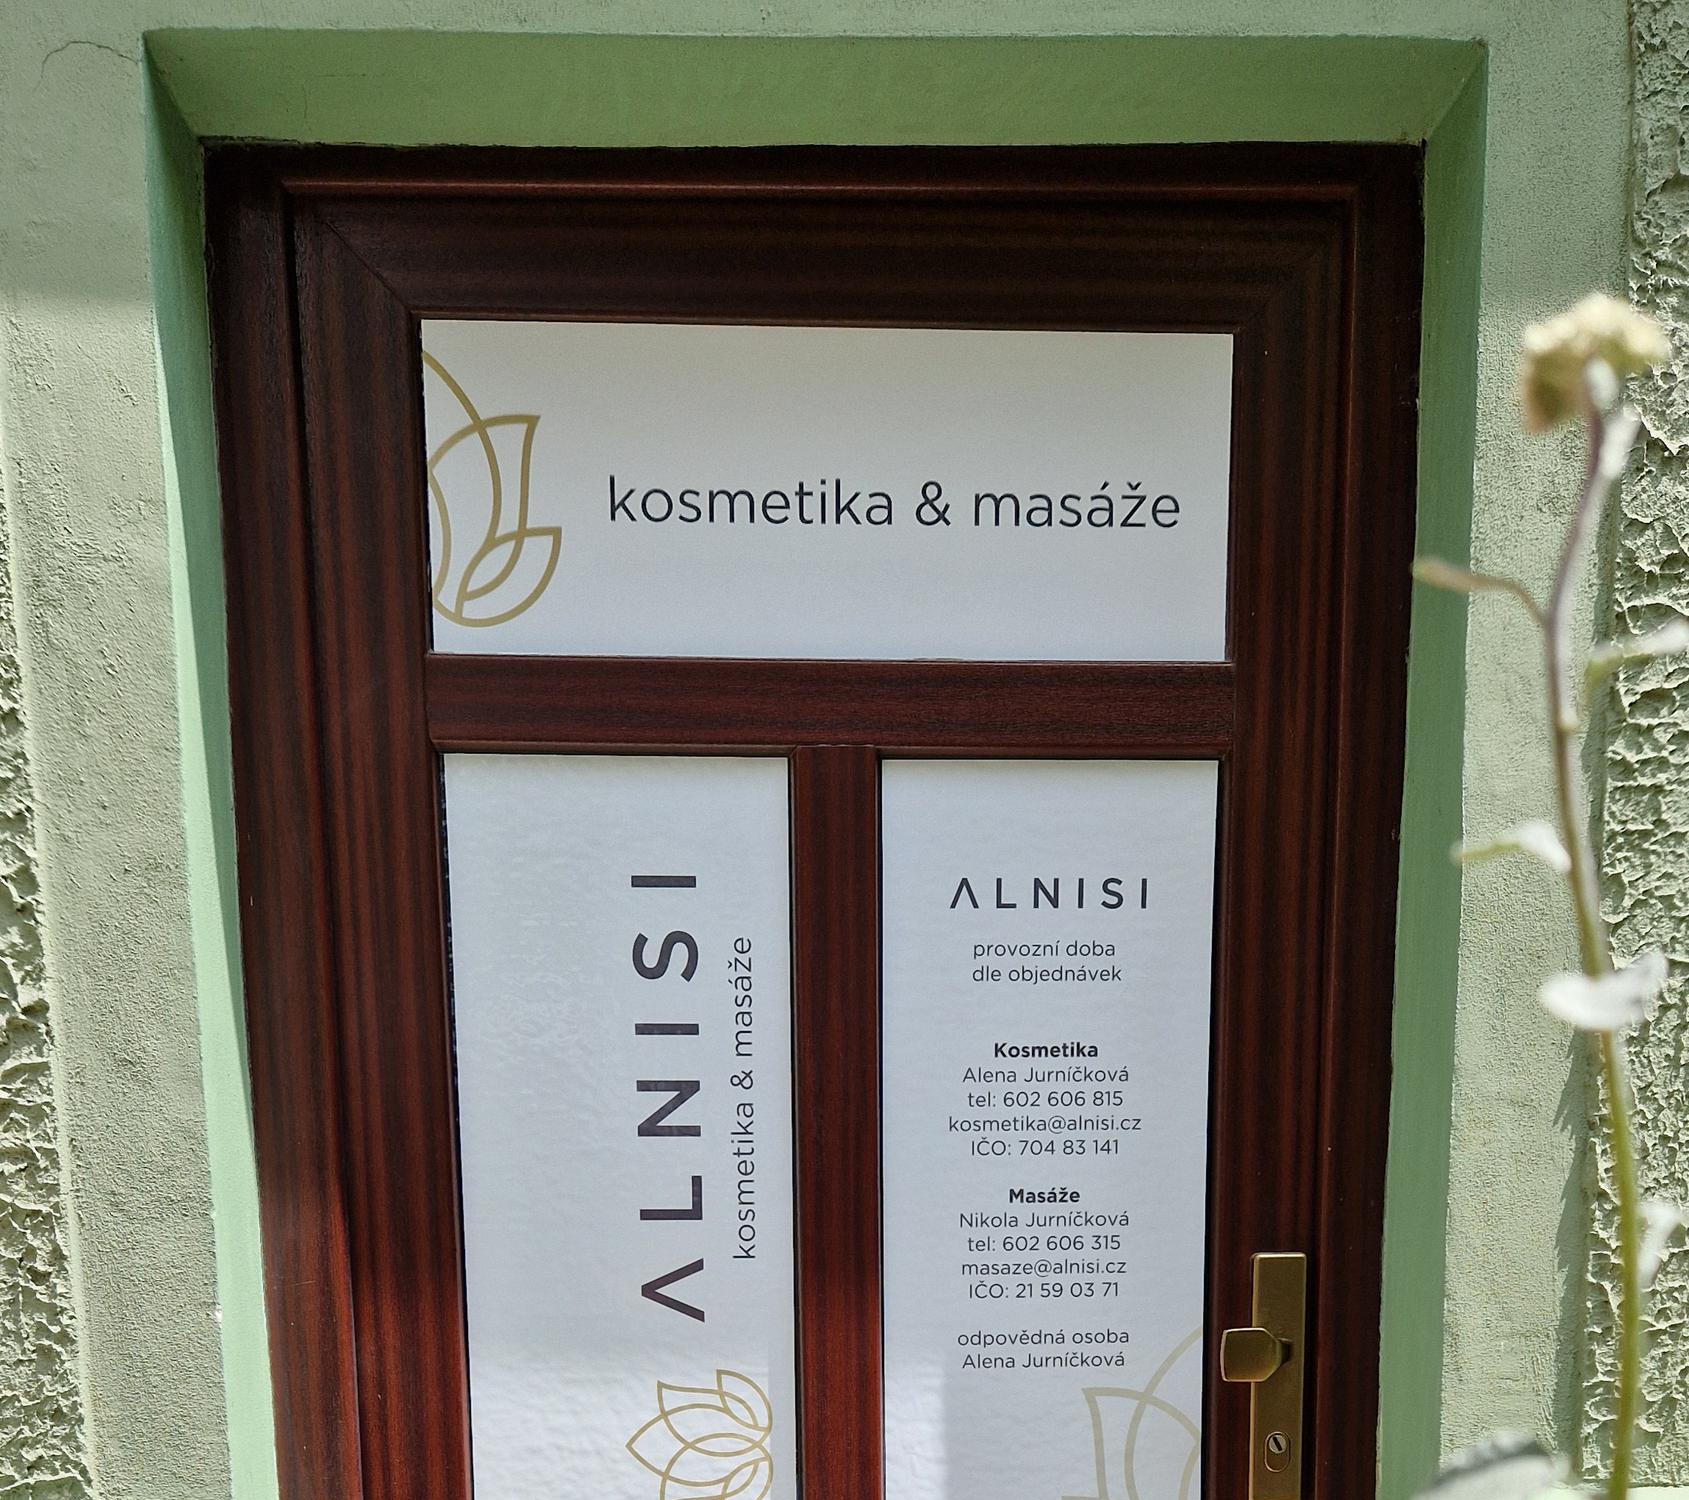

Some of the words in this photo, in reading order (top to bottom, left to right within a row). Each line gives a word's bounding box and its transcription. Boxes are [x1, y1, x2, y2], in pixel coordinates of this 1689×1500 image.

[610, 475, 893, 526] kosmetika
[916, 481, 952, 527] &
[974, 481, 1180, 529] masáže
[950, 878, 1148, 910] ALNISI
[974, 940, 1060, 960] provozní
[1064, 940, 1115, 959] doba
[972, 965, 1001, 984] dle
[1008, 965, 1122, 985] objednávek
[723, 937, 754, 1056] masáže
[994, 1041, 1098, 1058] Kosmetika
[730, 1070, 754, 1091] &
[962, 1067, 1016, 1083] Alena
[1024, 1066, 1128, 1084] Jurníčková
[631, 875, 705, 1323] ALNISI
[968, 1091, 996, 1107] tel:
[1003, 1091, 1040, 1108] 602
[1048, 1091, 1085, 1108] 606
[1093, 1090, 1123, 1106] 815
[949, 1115, 1142, 1134] kosmetika@alnisi.cz
[972, 1137, 1011, 1156] IČO:
[1018, 1140, 1056, 1157] 704
[1063, 1138, 1087, 1155] 83
[1093, 1139, 1118, 1155] 141
[730, 1103, 757, 1259] kosmetika
[1009, 1187, 1080, 1203] Masáže
[960, 1211, 1018, 1228] Nikola
[1026, 1209, 1129, 1228] Jurníčková
[968, 1236, 995, 1252] tel:
[1001, 1235, 1040, 1252] 602
[1047, 1235, 1084, 1250] 606
[1091, 1235, 1120, 1250] 315
[962, 1258, 1127, 1277] masaze@alnisi.cz
[970, 1280, 1008, 1299] IČO:
[1016, 1283, 1032, 1298] 21
[1040, 1283, 1063, 1298] 59
[1070, 1282, 1094, 1297] 03
[1102, 1282, 1118, 1297] 71
[958, 1329, 1065, 1348] odpovědná
[1072, 1328, 1129, 1344] osoba
[962, 1354, 1015, 1369] Alena
[1022, 1351, 1127, 1368] Jurníčková
